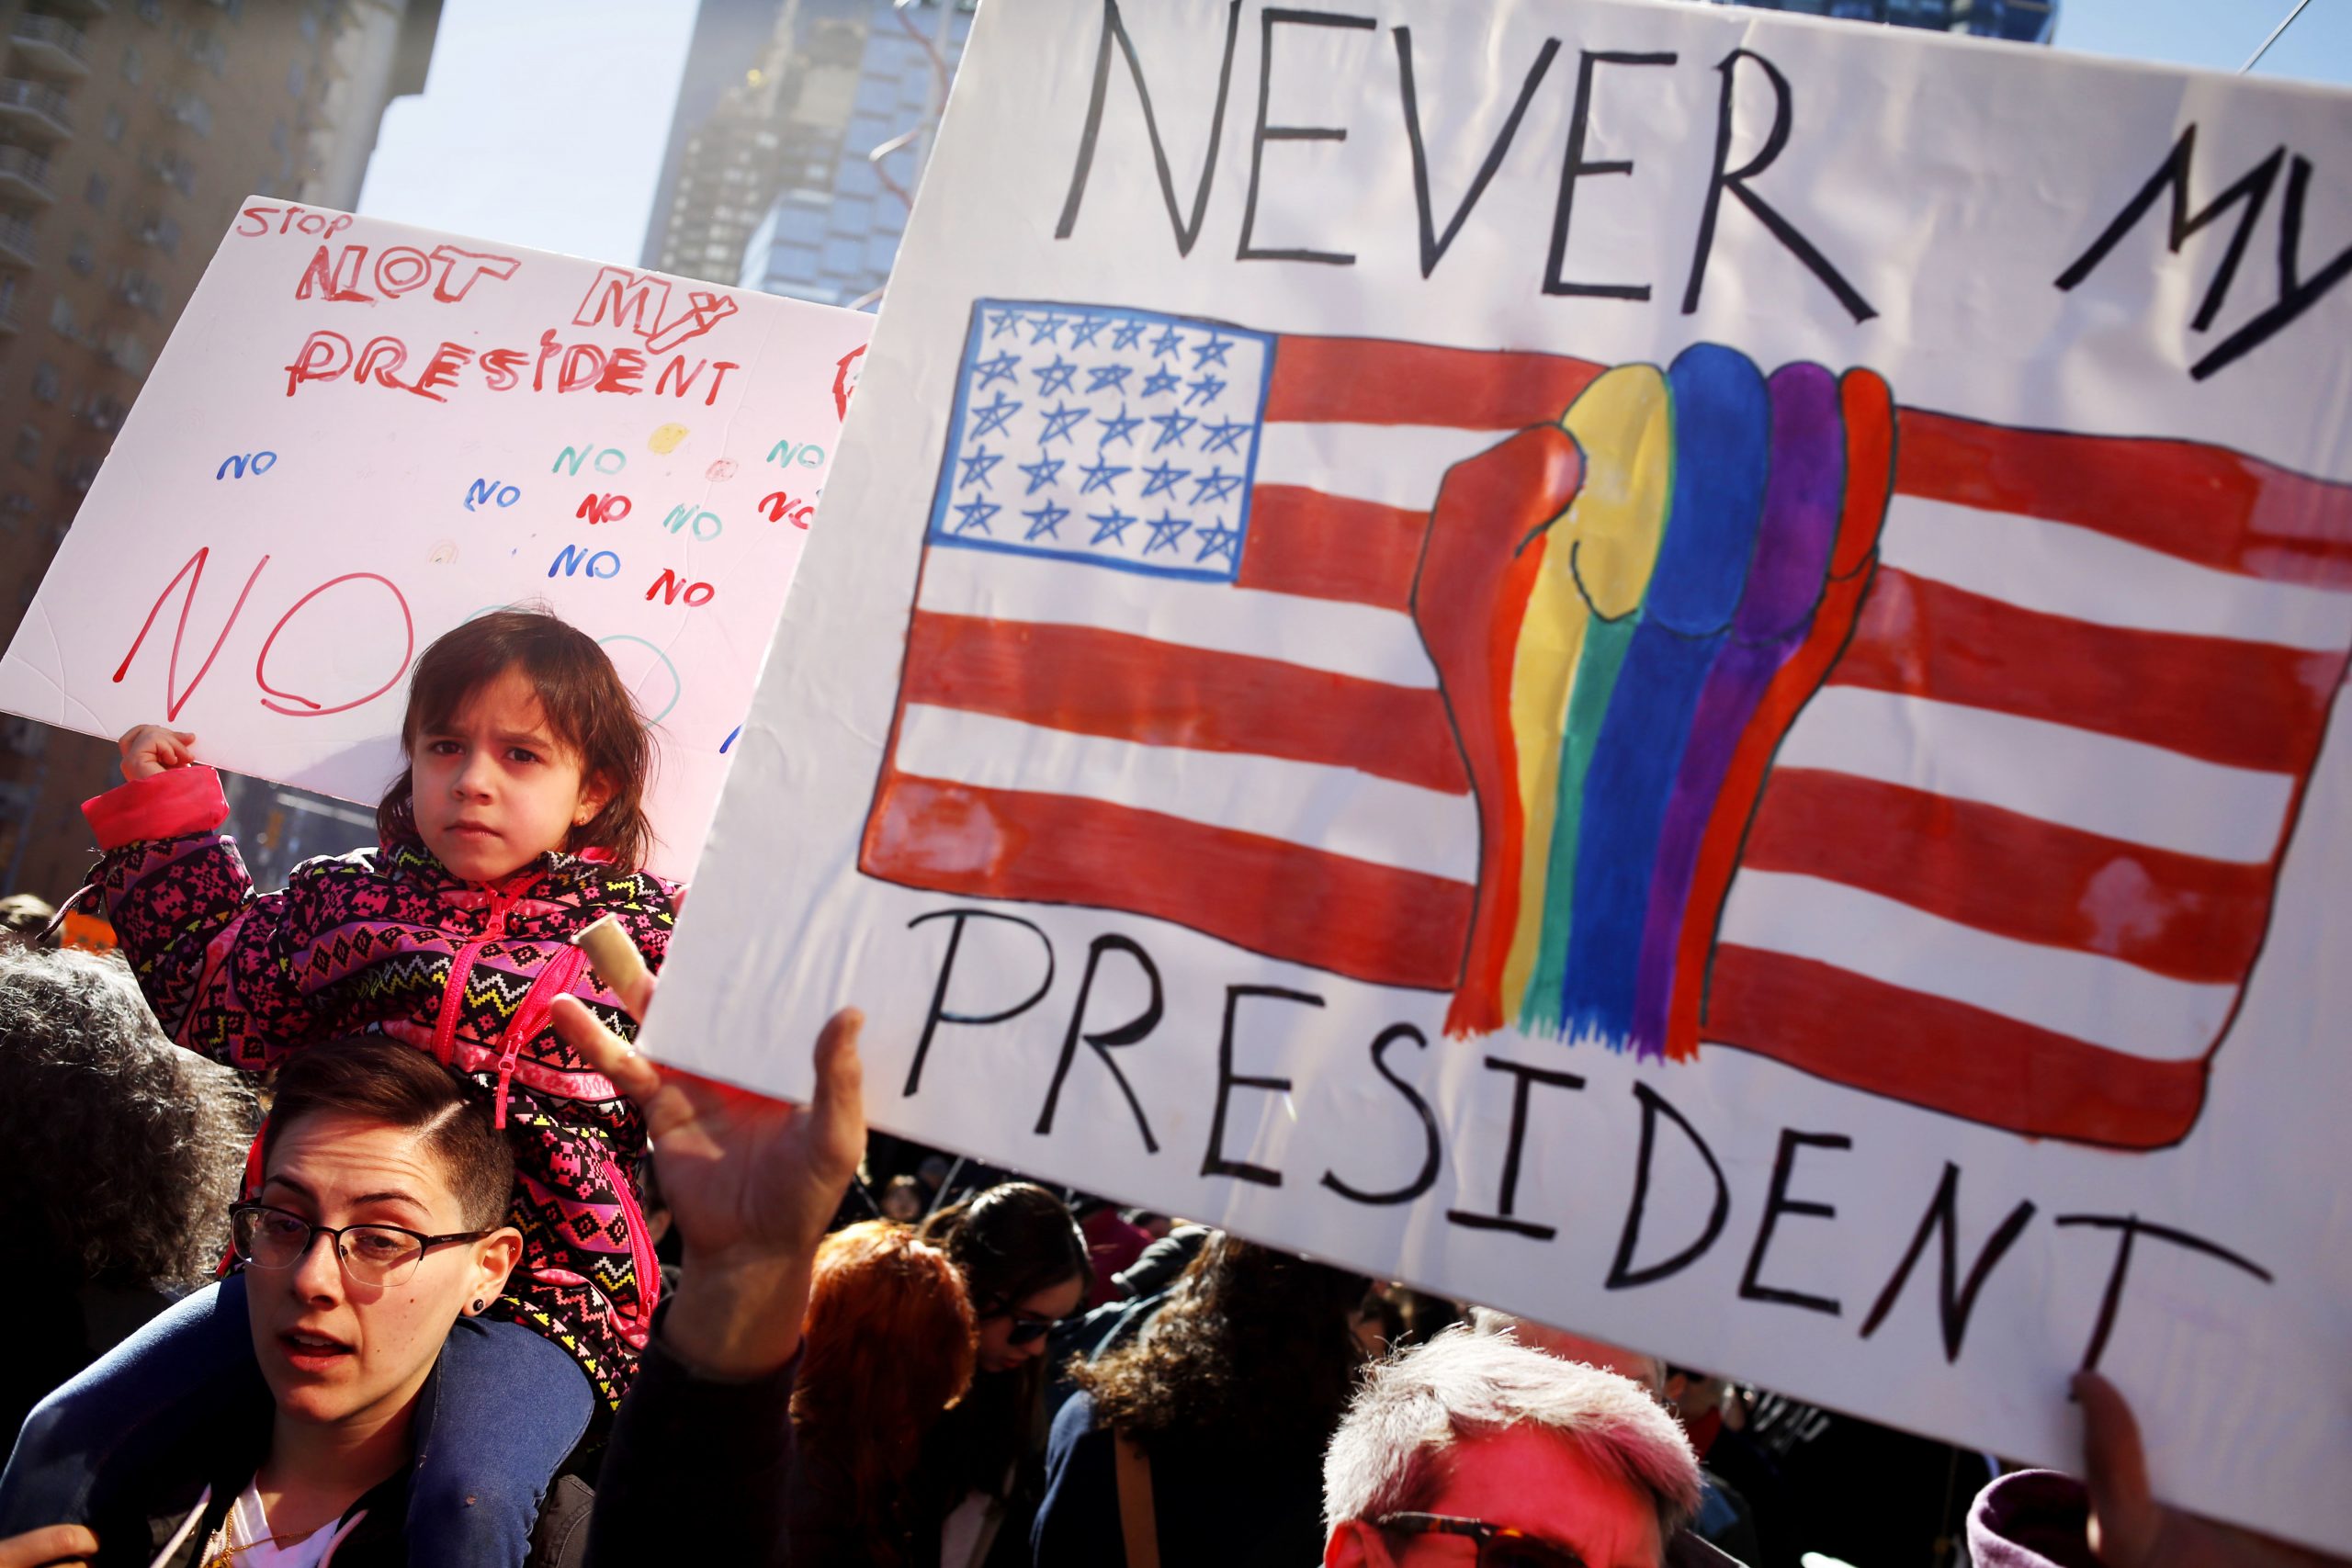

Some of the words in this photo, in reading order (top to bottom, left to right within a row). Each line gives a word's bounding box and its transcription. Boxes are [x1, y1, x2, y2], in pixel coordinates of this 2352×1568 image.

[1055, 0, 1880, 323] NEVER
[2055, 121, 2352, 381] MY
[237, 206, 354, 239] STOP
[295, 245, 521, 307] NOT
[571, 266, 739, 355] MY
[216, 451, 277, 480] NO
[551, 445, 628, 475] NO
[766, 440, 825, 468] NO
[464, 478, 521, 512] NO
[576, 492, 631, 525] NO
[662, 503, 723, 542] NO
[548, 544, 621, 579] NO
[645, 568, 715, 607] NO
[112, 547, 413, 722] NO
[905, 908, 2275, 1401] PRESIDENT
